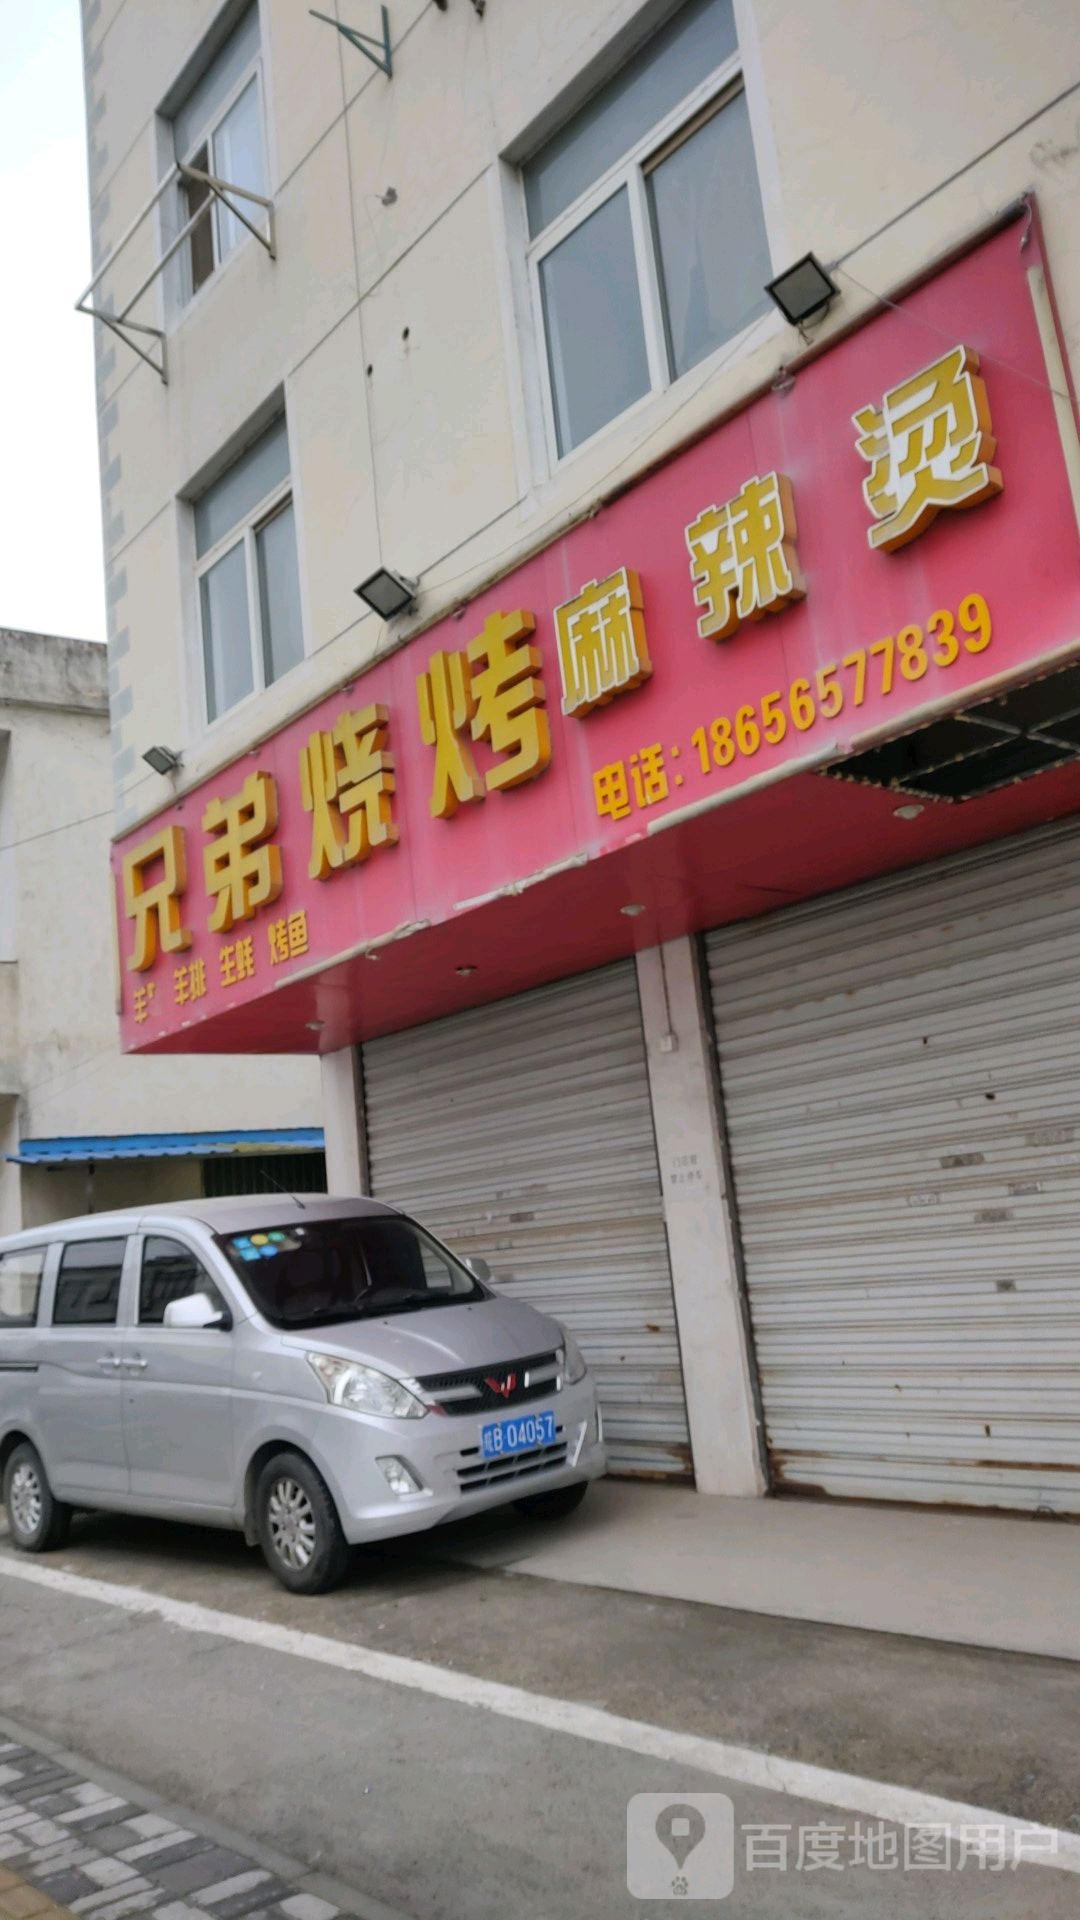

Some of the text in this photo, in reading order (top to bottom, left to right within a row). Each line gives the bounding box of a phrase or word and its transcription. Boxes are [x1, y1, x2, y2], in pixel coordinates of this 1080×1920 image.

[121, 343, 1004, 973] 兄弟烧烤 麻辣烫
[133, 981, 157, 1024] 羊
[219, 935, 255, 988] 生蚝
[267, 910, 310, 967] 烤鱼
